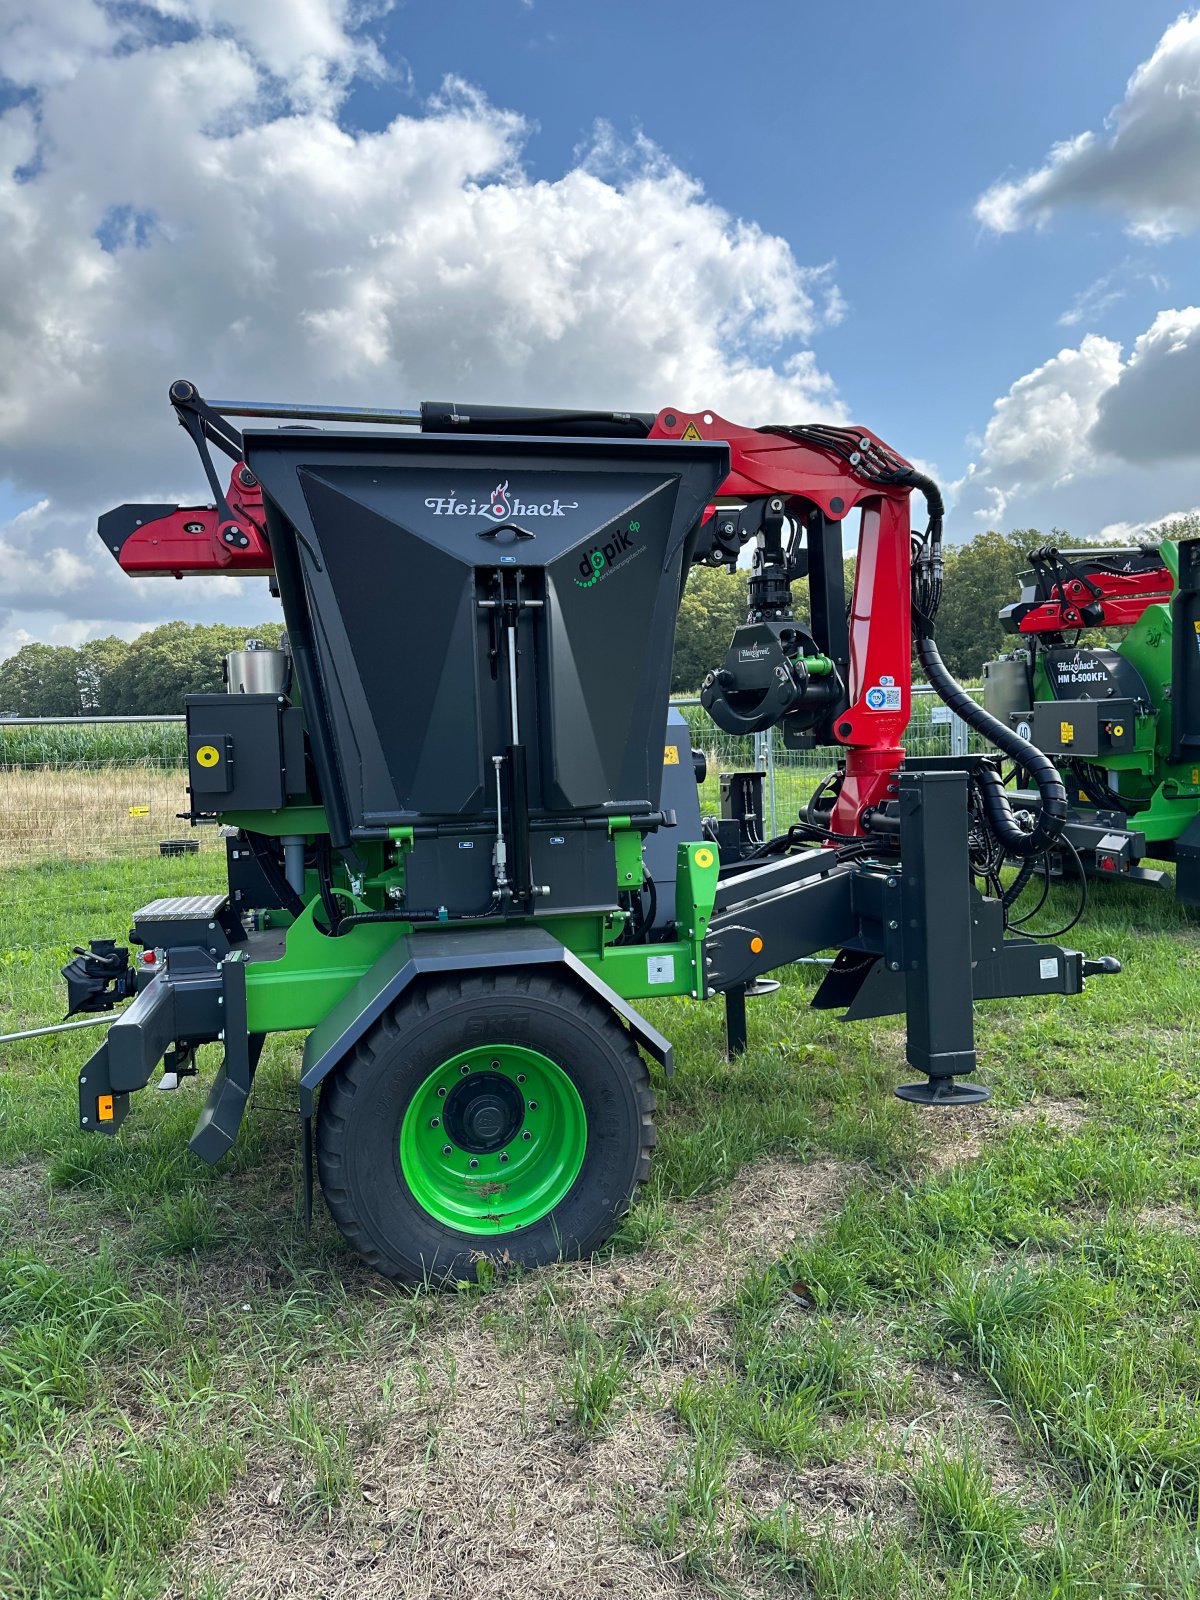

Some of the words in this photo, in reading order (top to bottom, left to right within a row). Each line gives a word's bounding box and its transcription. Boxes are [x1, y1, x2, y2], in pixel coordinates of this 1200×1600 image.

[579, 529, 634, 577] döpik
[1058, 675, 1069, 683] HM
[1071, 672, 1108, 683] 8-500KFL
